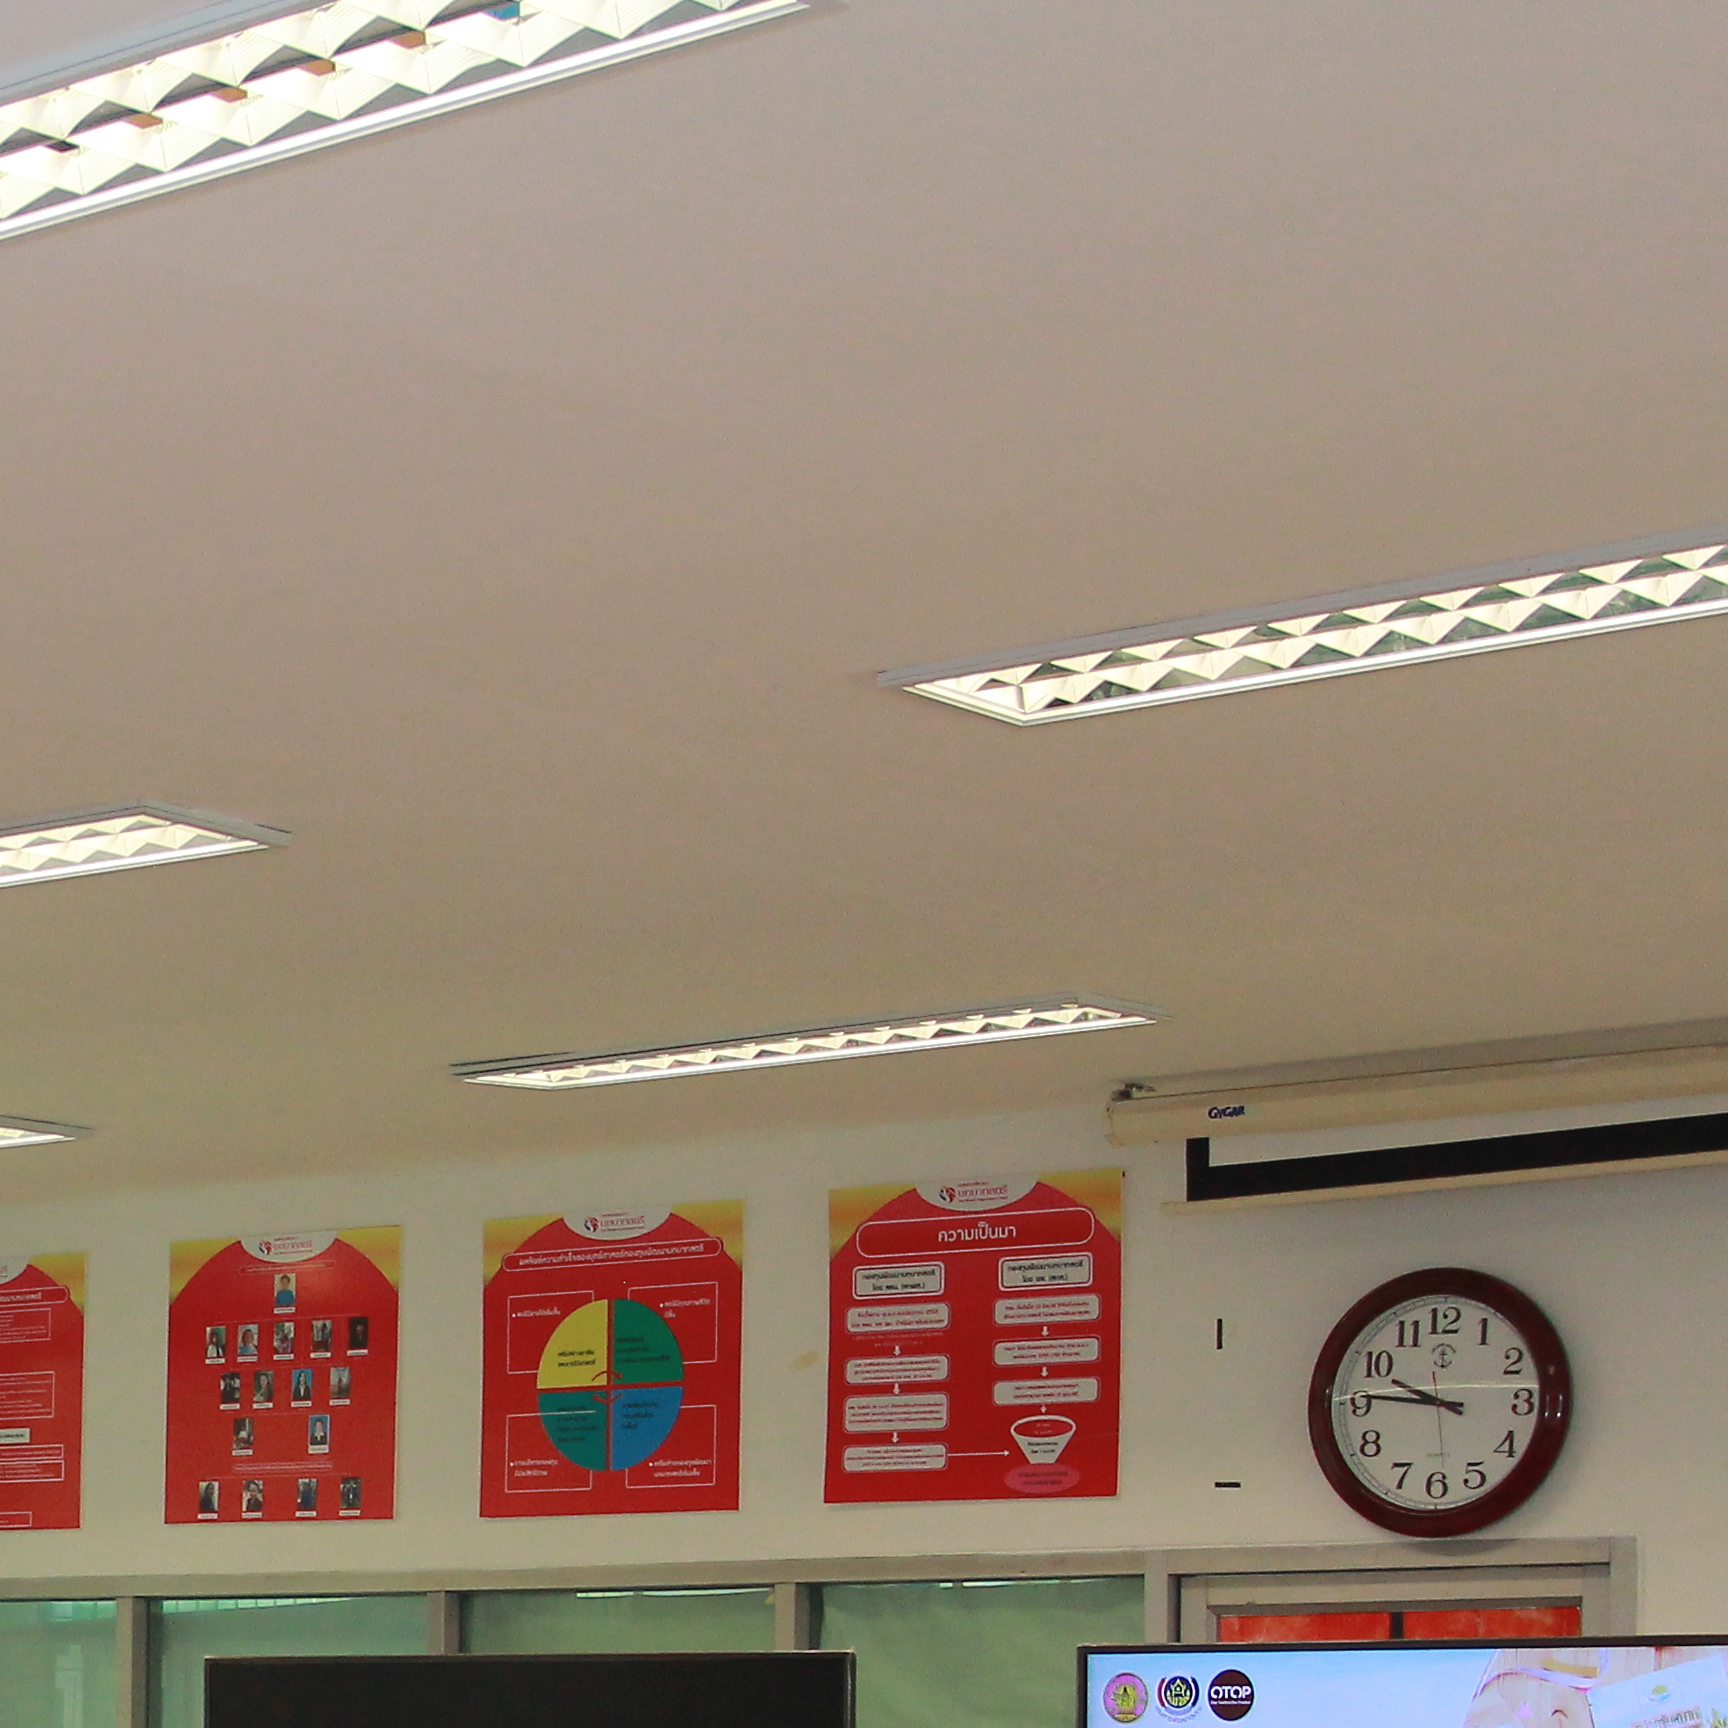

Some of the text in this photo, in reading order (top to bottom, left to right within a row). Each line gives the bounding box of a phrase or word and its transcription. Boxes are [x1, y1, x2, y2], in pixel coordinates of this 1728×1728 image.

[937, 1220, 1017, 1243] ความเป็นมา
[1395, 1320, 1421, 1348] 11
[1427, 1306, 1462, 1335] 12
[1478, 1318, 1489, 1346] 1
[1363, 1350, 1394, 1379] 10
[1502, 1347, 1523, 1375] 2
[1350, 1390, 1372, 1417] 9
[1511, 1388, 1534, 1416] 3
[1359, 1429, 1382, 1457] 8
[1493, 1430, 1516, 1458] 4
[1391, 1461, 1413, 1489] 7
[1425, 1471, 1448, 1499] 6
[1462, 1461, 1486, 1489] 5
[1210, 1685, 1252, 1699] OTOP
